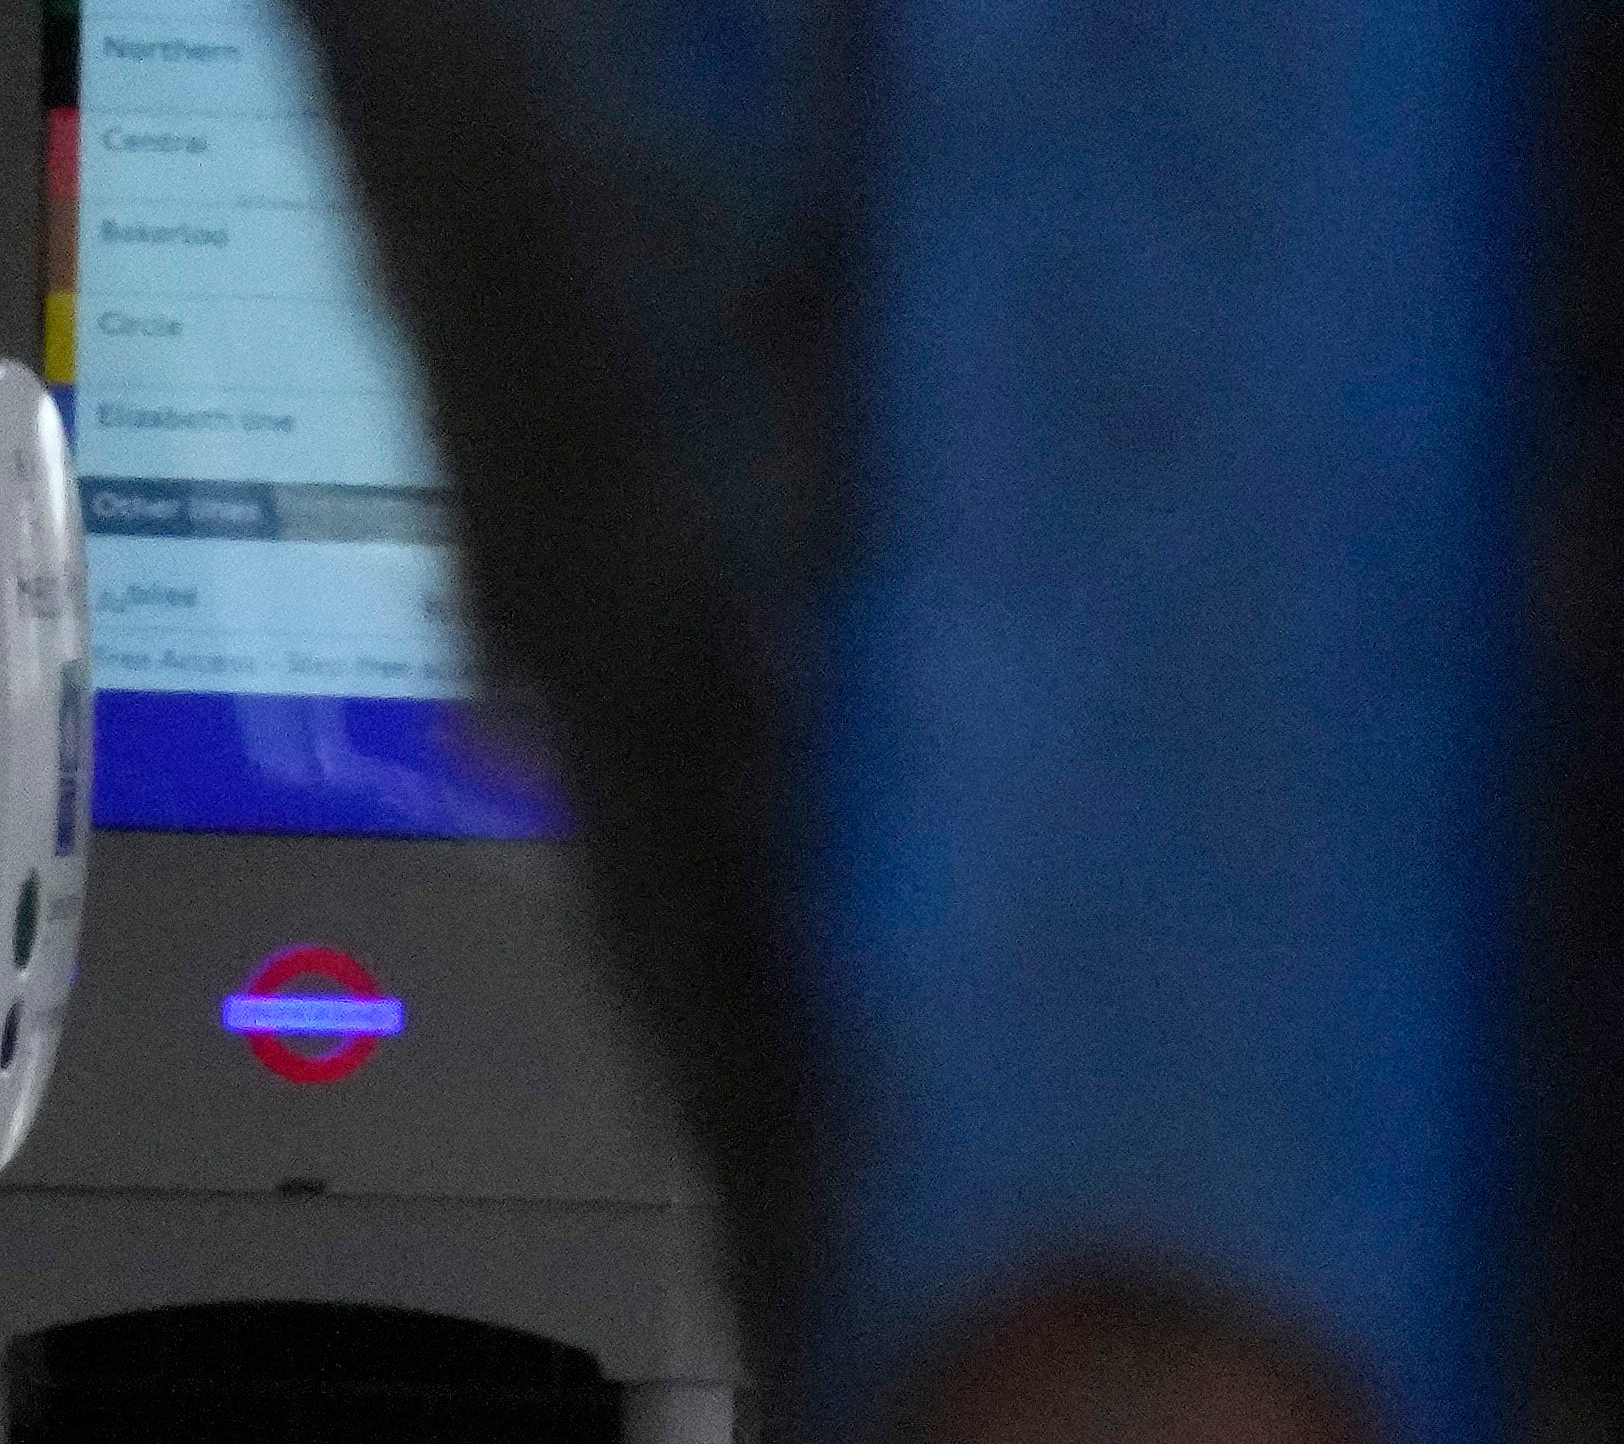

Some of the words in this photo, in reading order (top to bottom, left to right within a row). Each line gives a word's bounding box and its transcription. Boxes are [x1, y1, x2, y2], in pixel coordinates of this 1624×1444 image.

[102, 35, 240, 63] Northern
[102, 126, 208, 155] Central
[98, 309, 183, 338] Circle
